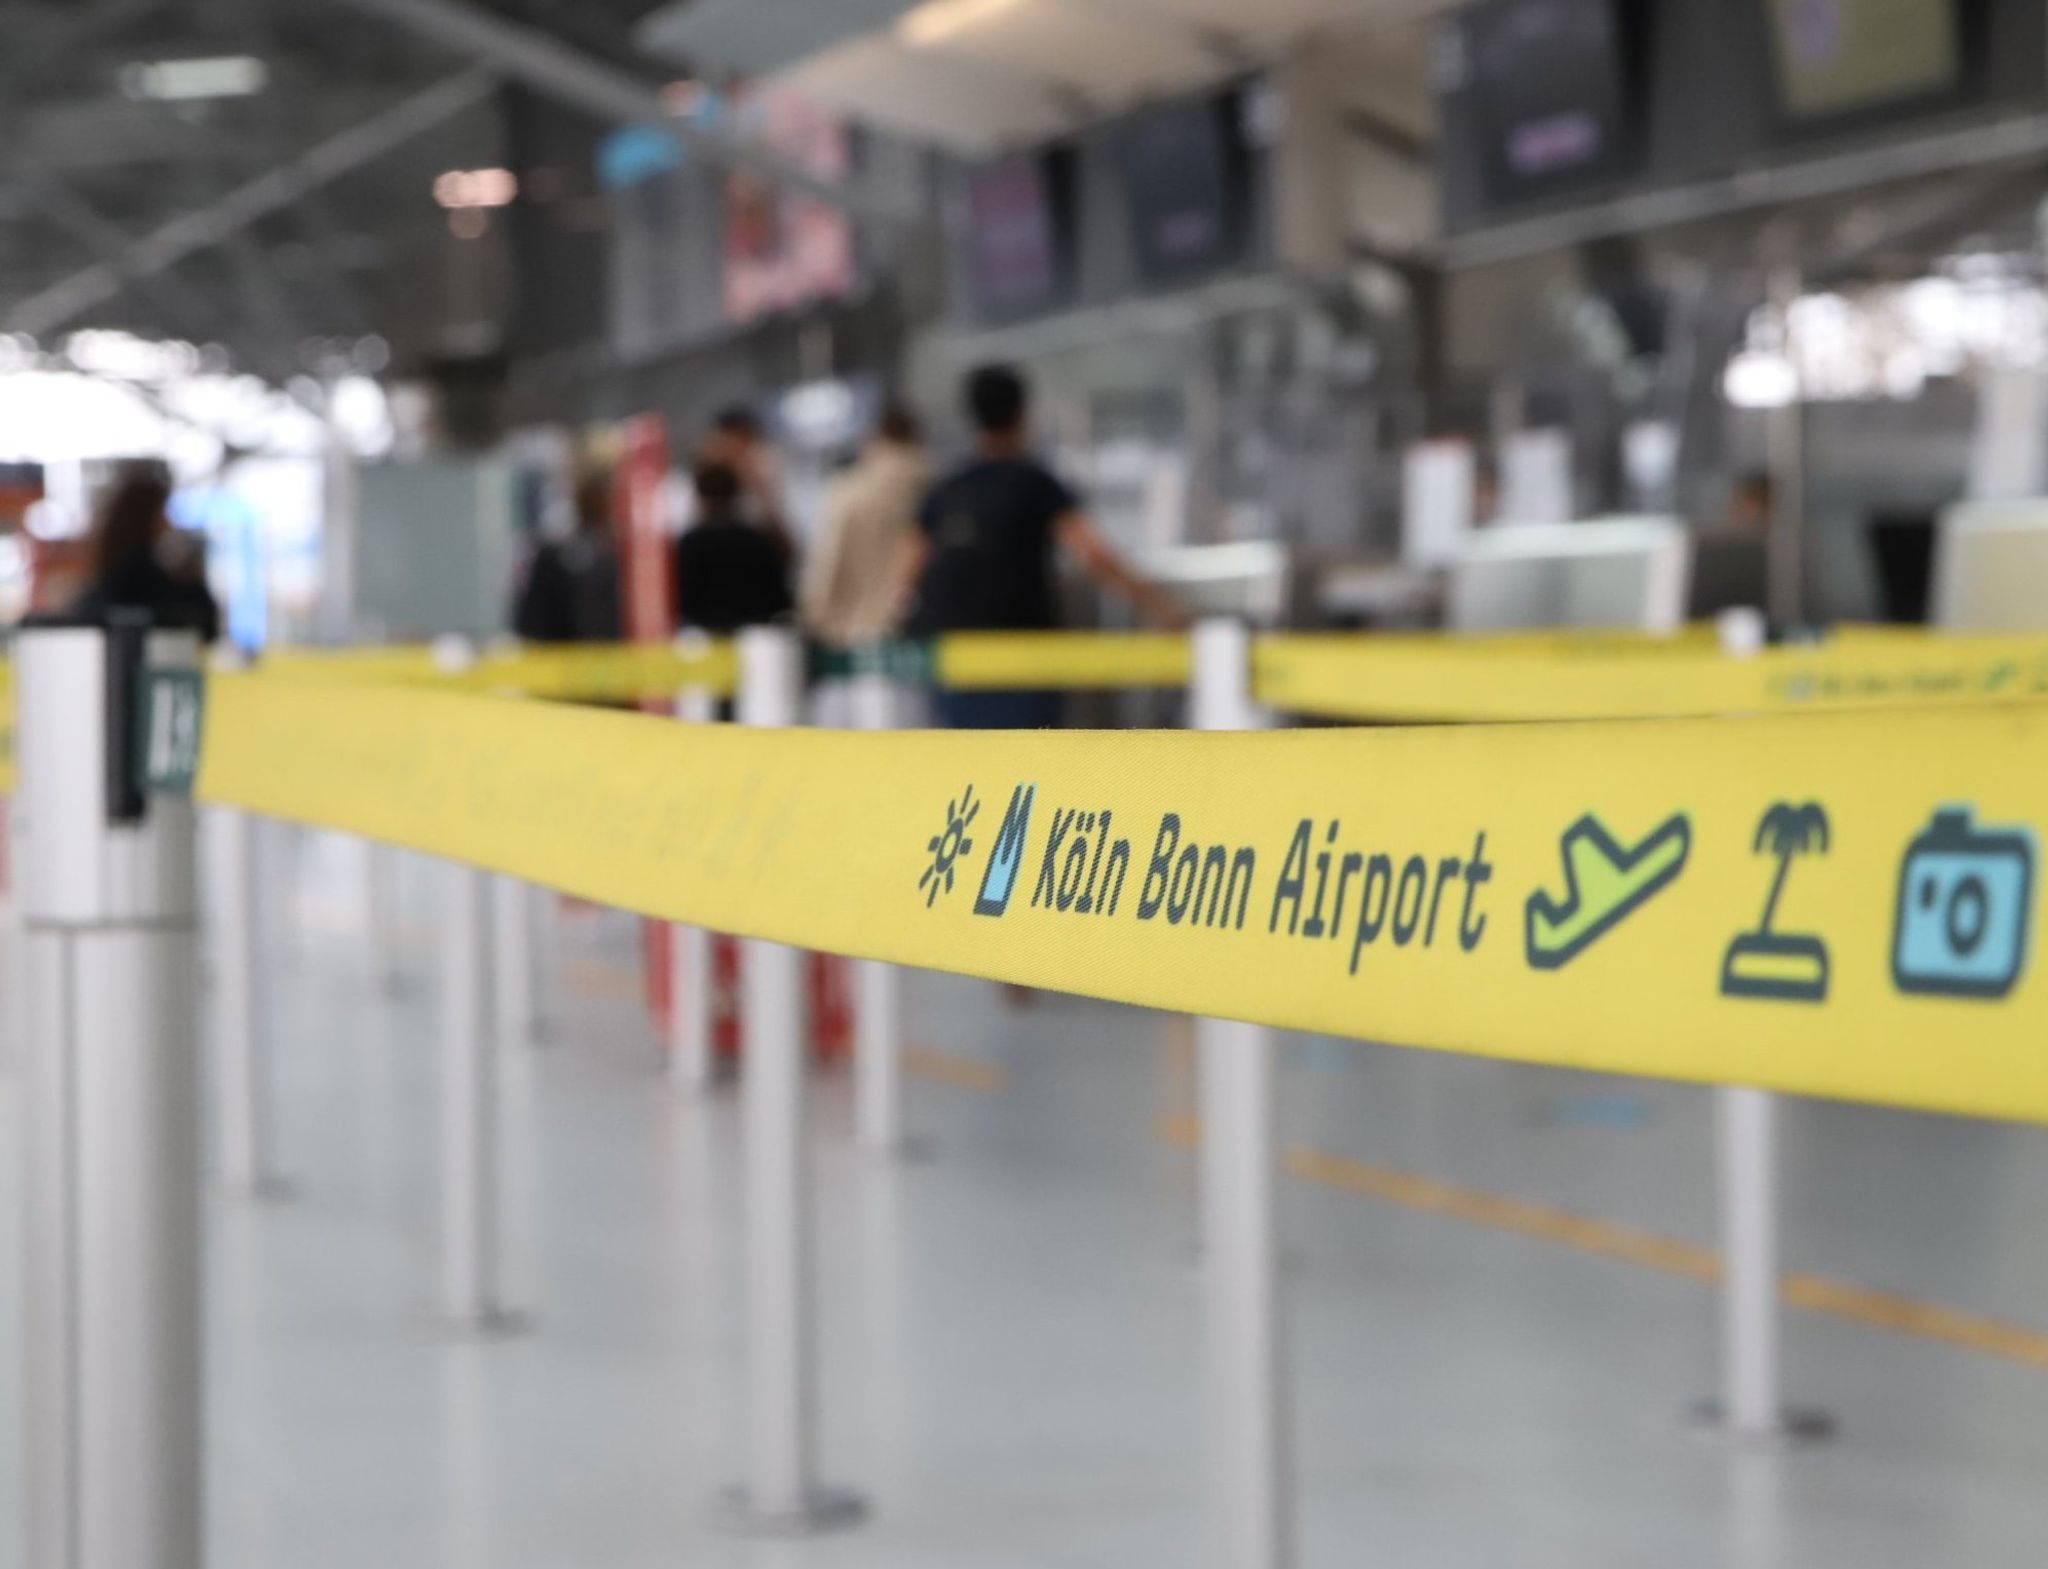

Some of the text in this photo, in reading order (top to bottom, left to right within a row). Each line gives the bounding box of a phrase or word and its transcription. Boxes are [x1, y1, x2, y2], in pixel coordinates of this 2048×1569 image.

[1031, 807, 1493, 976] Köln Bonn Airport
